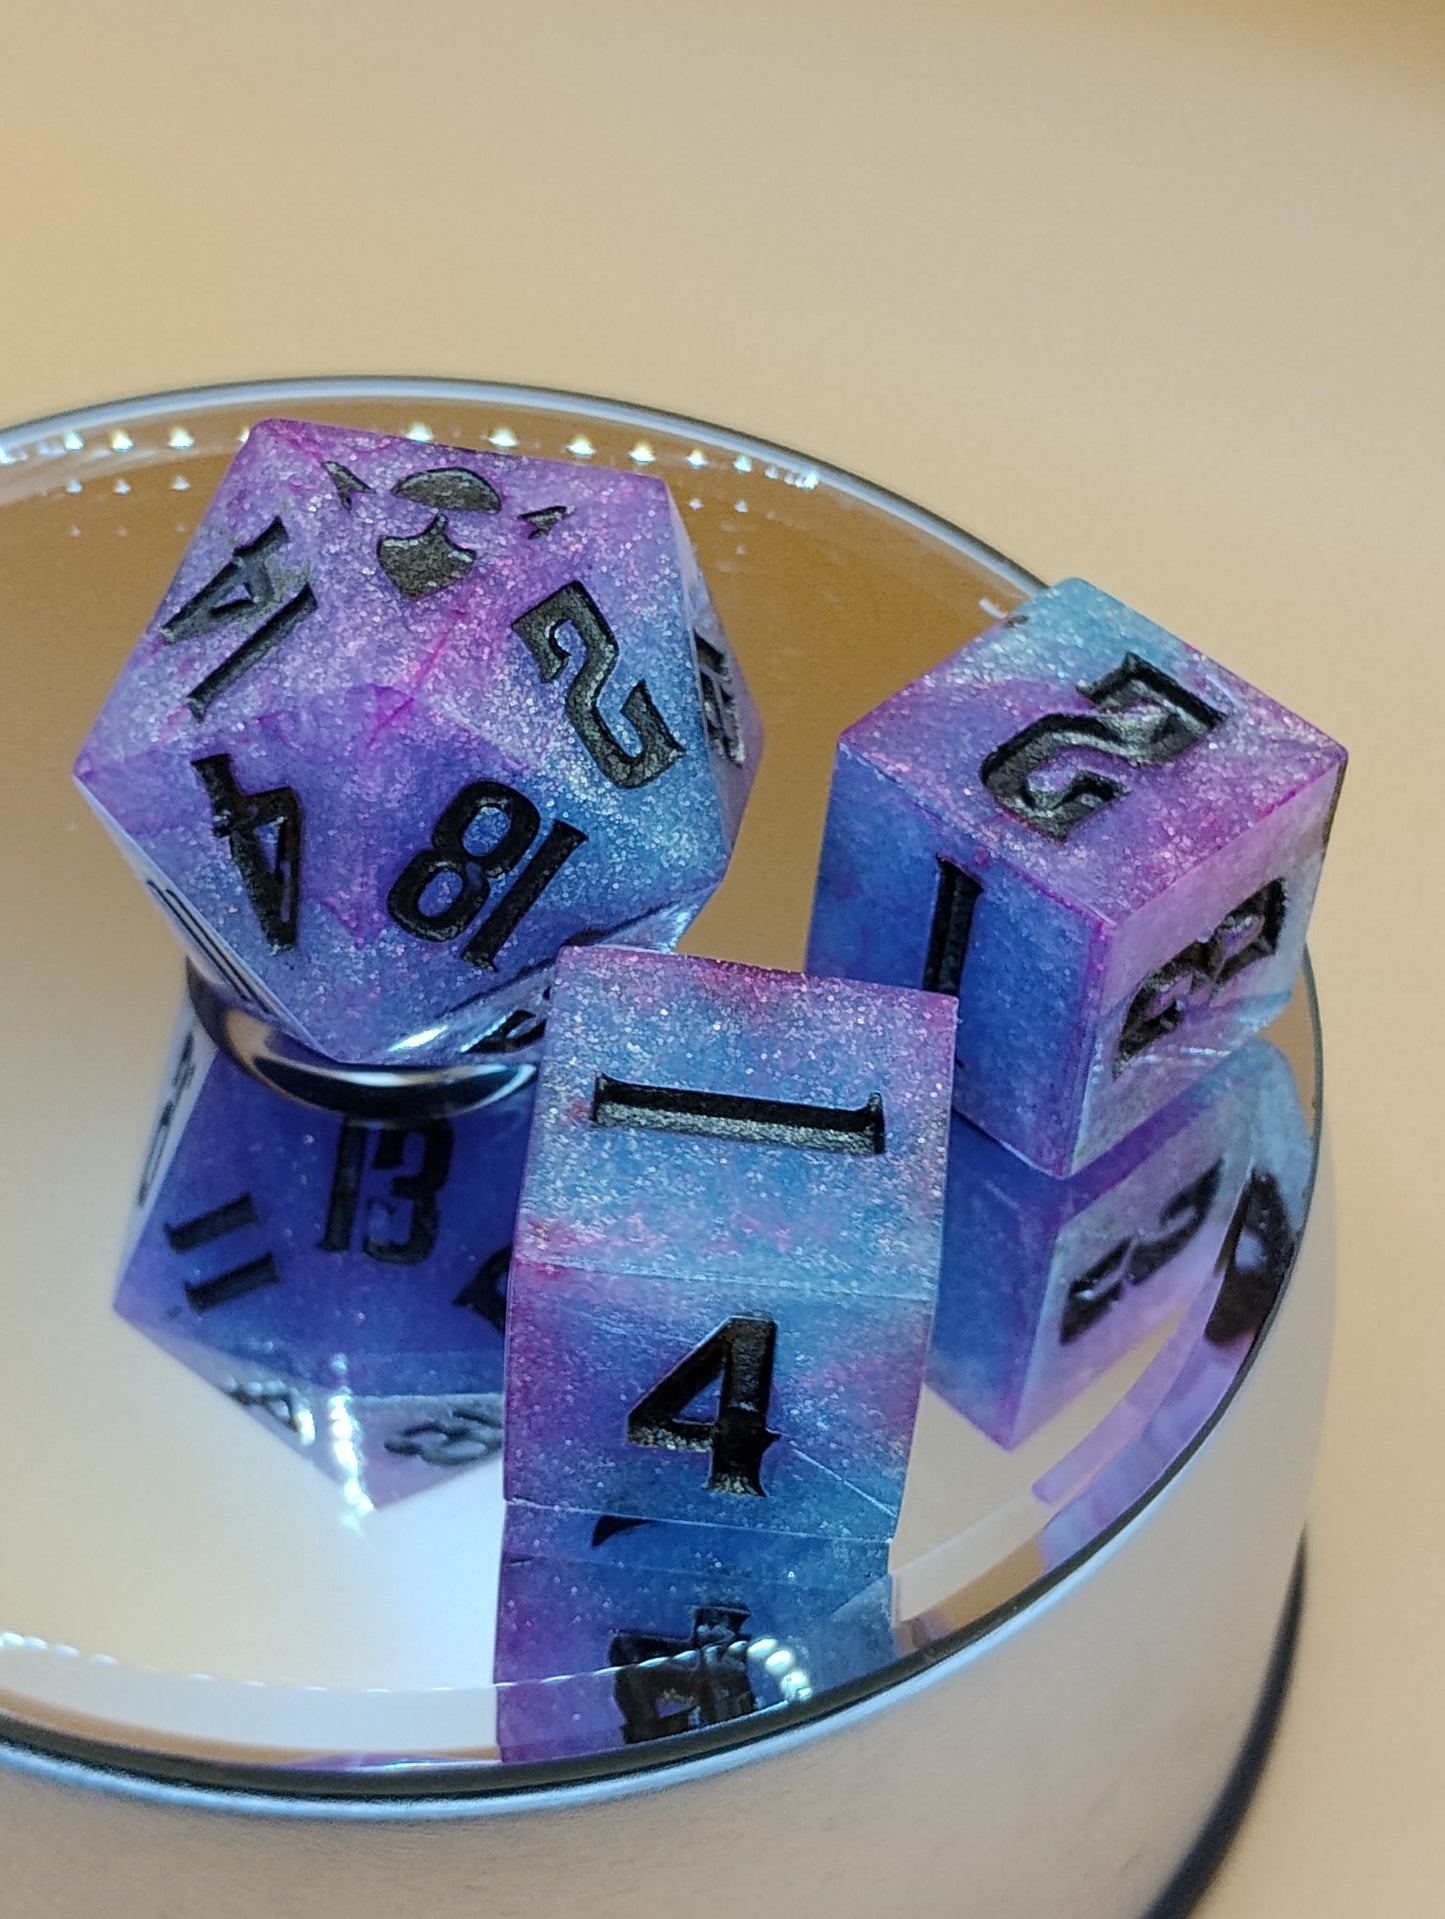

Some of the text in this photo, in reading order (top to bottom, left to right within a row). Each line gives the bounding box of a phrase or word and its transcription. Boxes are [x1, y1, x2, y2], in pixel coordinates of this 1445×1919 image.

[511, 580, 687, 789] 2
[979, 652, 1228, 844] 2
[191, 752, 302, 955] 4
[386, 781, 588, 973] 18
[922, 854, 984, 998] 1
[592, 1072, 886, 1155] 1
[628, 1311, 781, 1498] 4
